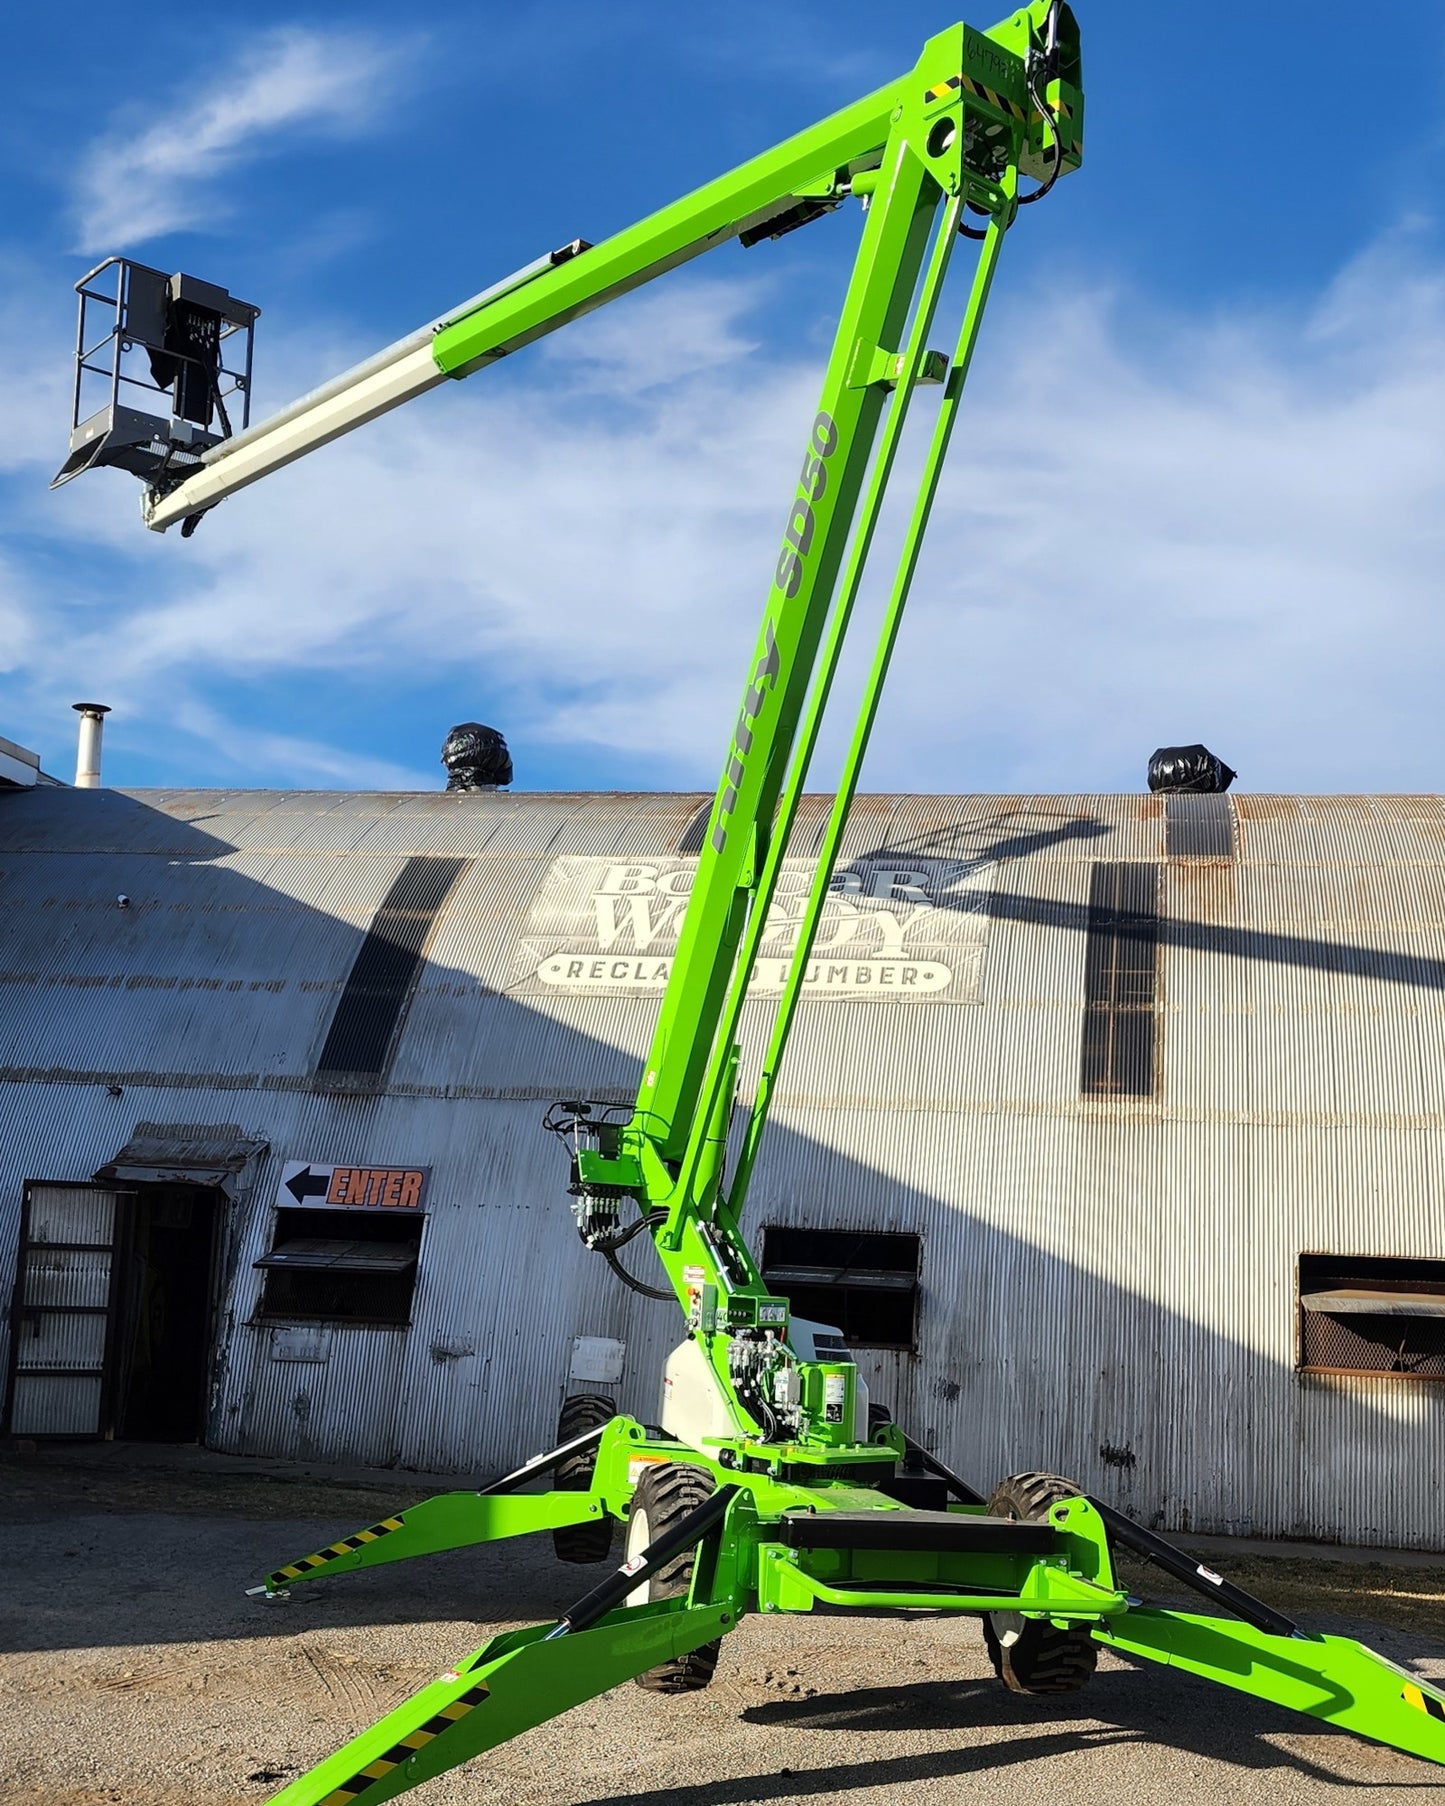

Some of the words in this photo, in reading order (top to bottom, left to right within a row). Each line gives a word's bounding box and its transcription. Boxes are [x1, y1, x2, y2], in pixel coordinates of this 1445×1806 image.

[775, 410, 840, 600] SD50
[779, 964, 918, 985] LUMBER
[325, 1167, 424, 1208] ENTER
